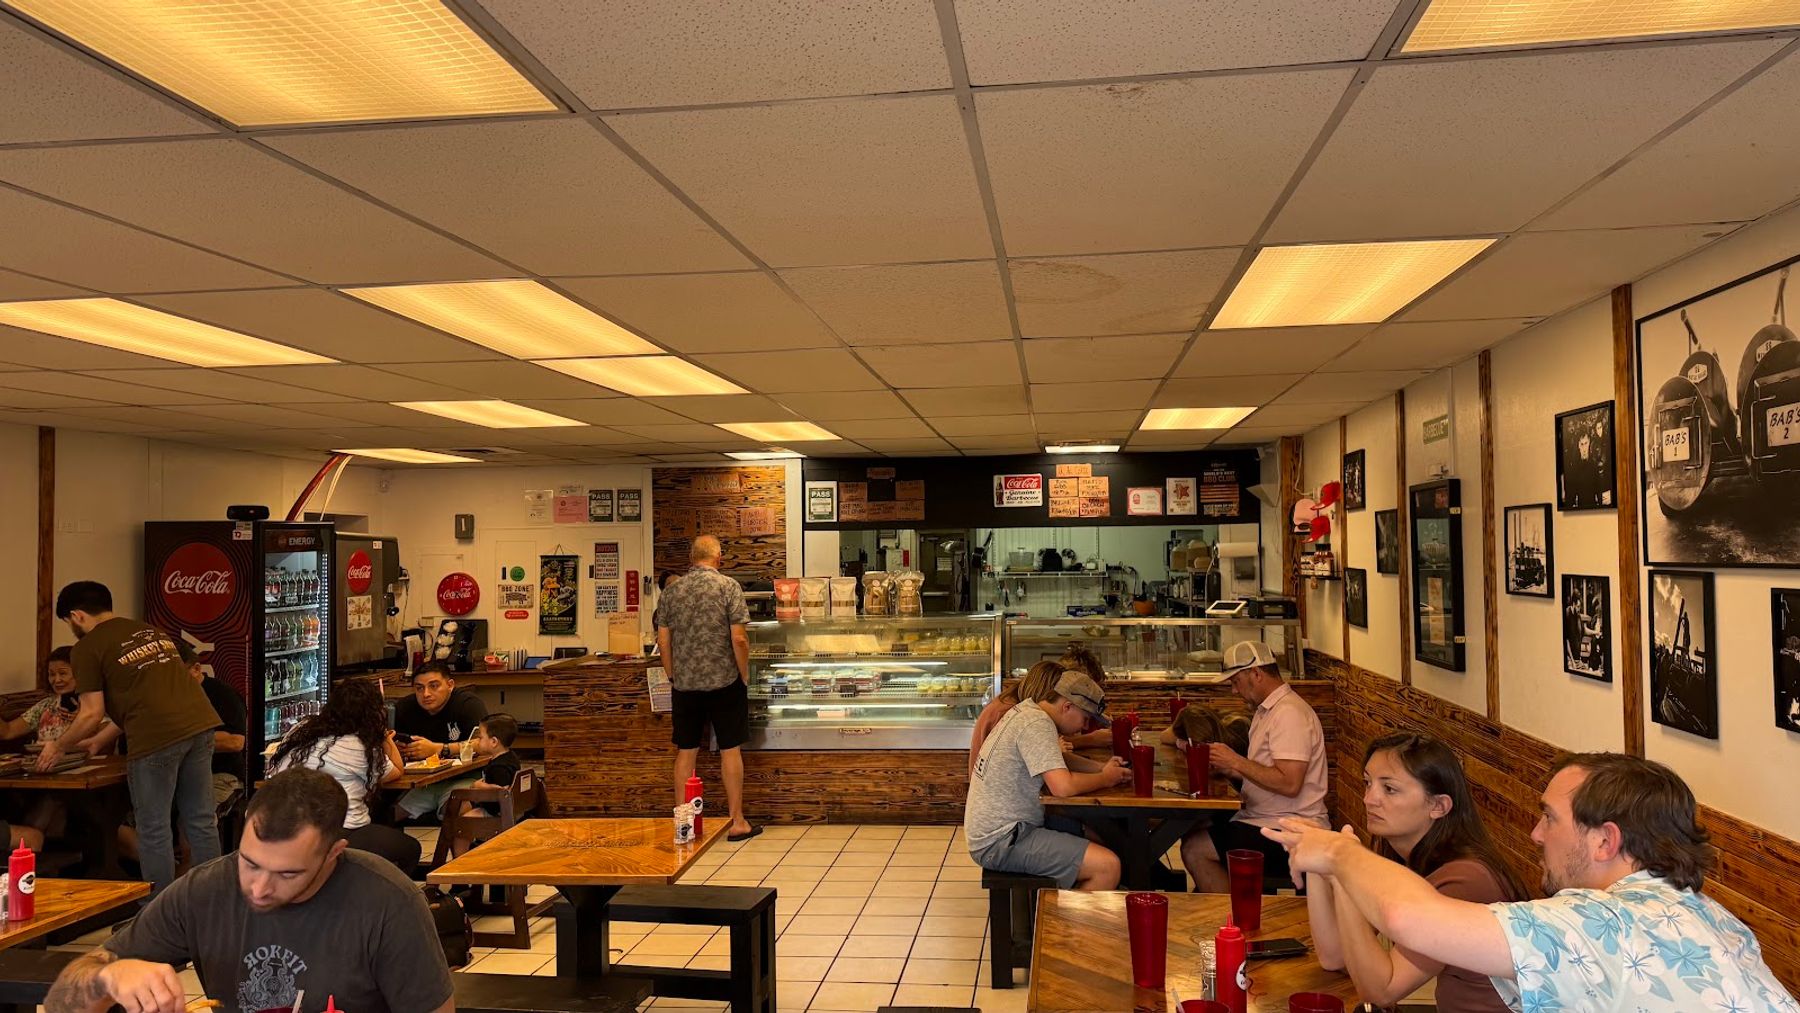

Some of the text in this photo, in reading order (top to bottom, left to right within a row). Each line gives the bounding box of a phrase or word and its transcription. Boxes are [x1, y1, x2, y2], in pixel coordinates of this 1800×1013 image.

[1769, 405, 1800, 427] BAB'S
[1664, 431, 1687, 447] BAB'S
[1783, 427, 1789, 440] 2
[1673, 447, 1678, 457] 1
[1203, 475, 1217, 483] BBQ
[288, 537, 316, 546] ENERGY
[347, 564, 372, 580] Coca-Cola
[164, 570, 233, 595] Coca-Cola
[117, 640, 161, 666] WHISKEY
